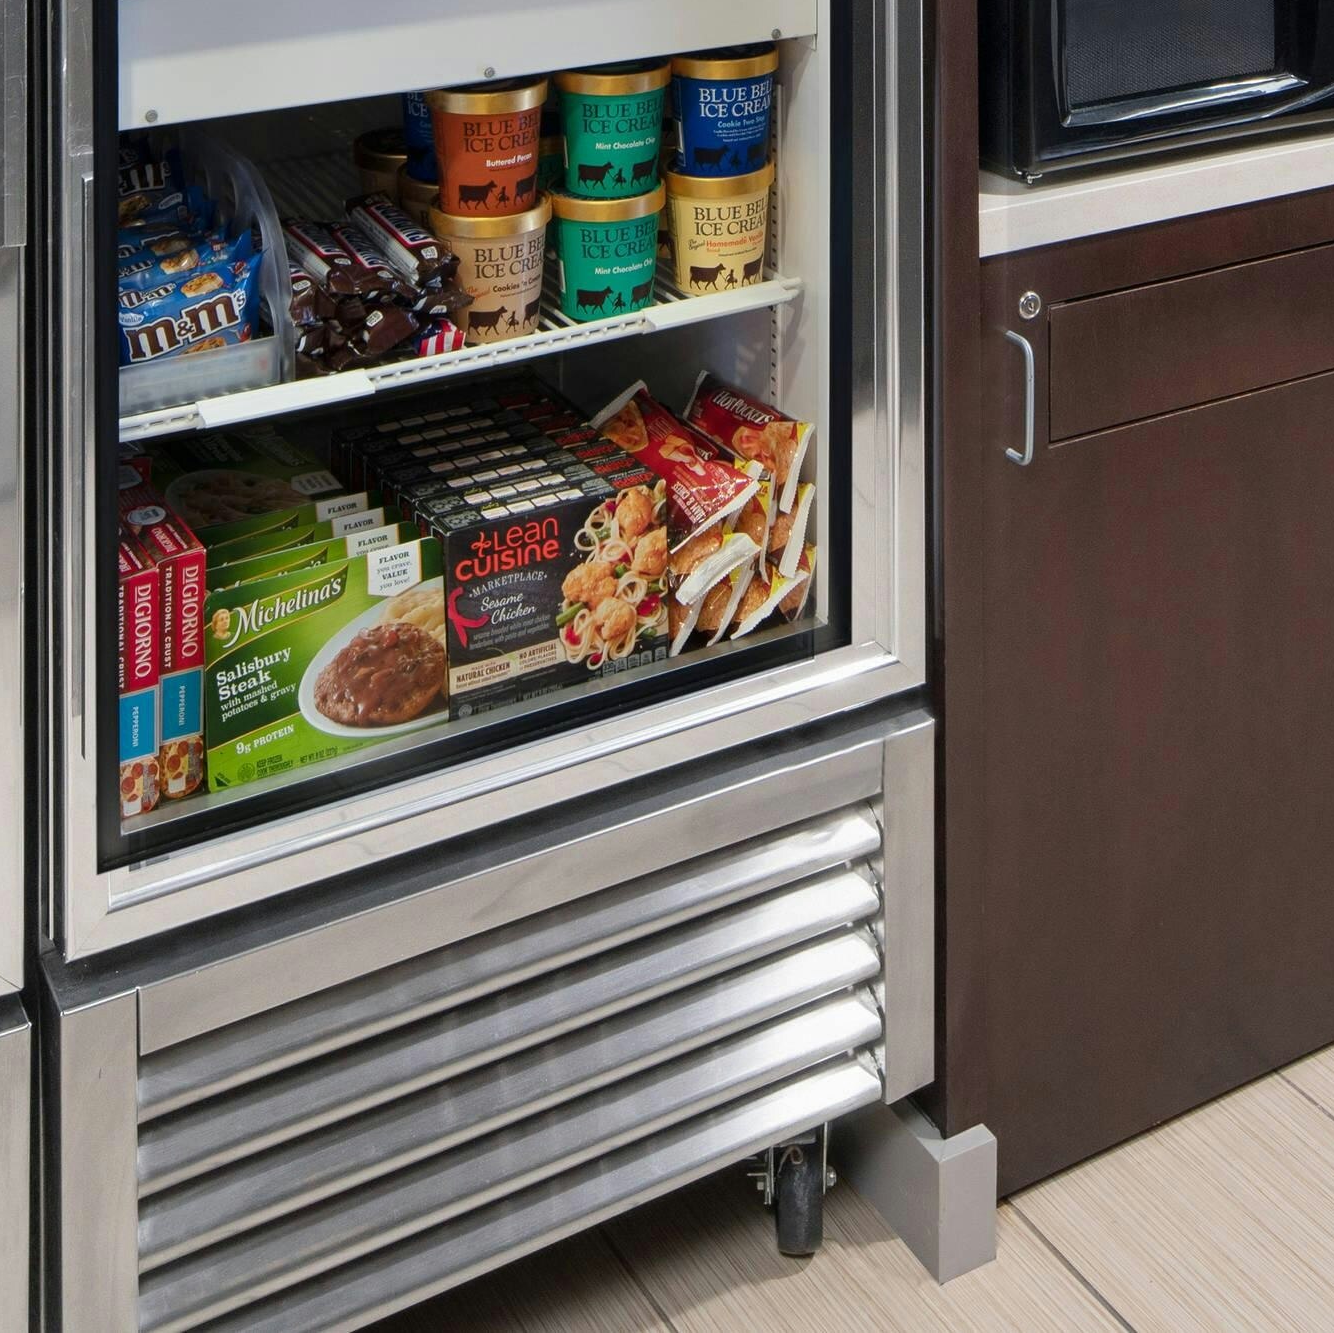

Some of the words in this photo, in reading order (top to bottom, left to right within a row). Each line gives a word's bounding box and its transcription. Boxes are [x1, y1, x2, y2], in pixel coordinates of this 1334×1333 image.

[699, 87, 747, 103] BLUE
[486, 157, 515, 167] Buttered
[516, 152, 532, 164] Pecan
[694, 206, 742, 222] BLUE
[706, 236, 748, 248] Homemade
[494, 517, 559, 551] Lean
[164, 566, 172, 633] TRADITIONAL
[472, 572, 545, 598] MARKETPLACE
[181, 564, 199, 659] DIGIORNO
[223, 576, 342, 650] Michelina's
[480, 591, 524, 613] Sesame
[490, 605, 536, 626] Chicken
[134, 584, 152, 679] DIGIORNO
[216, 647, 292, 687] Salisbury
[218, 670, 272, 702] Steak
[221, 698, 242, 712] with
[243, 680, 278, 705] mashed
[178, 685, 186, 727] PEPPERONI
[222, 698, 259, 722] potatoes
[269, 684, 297, 704] gravy
[254, 724, 295, 749] PROTEIN
